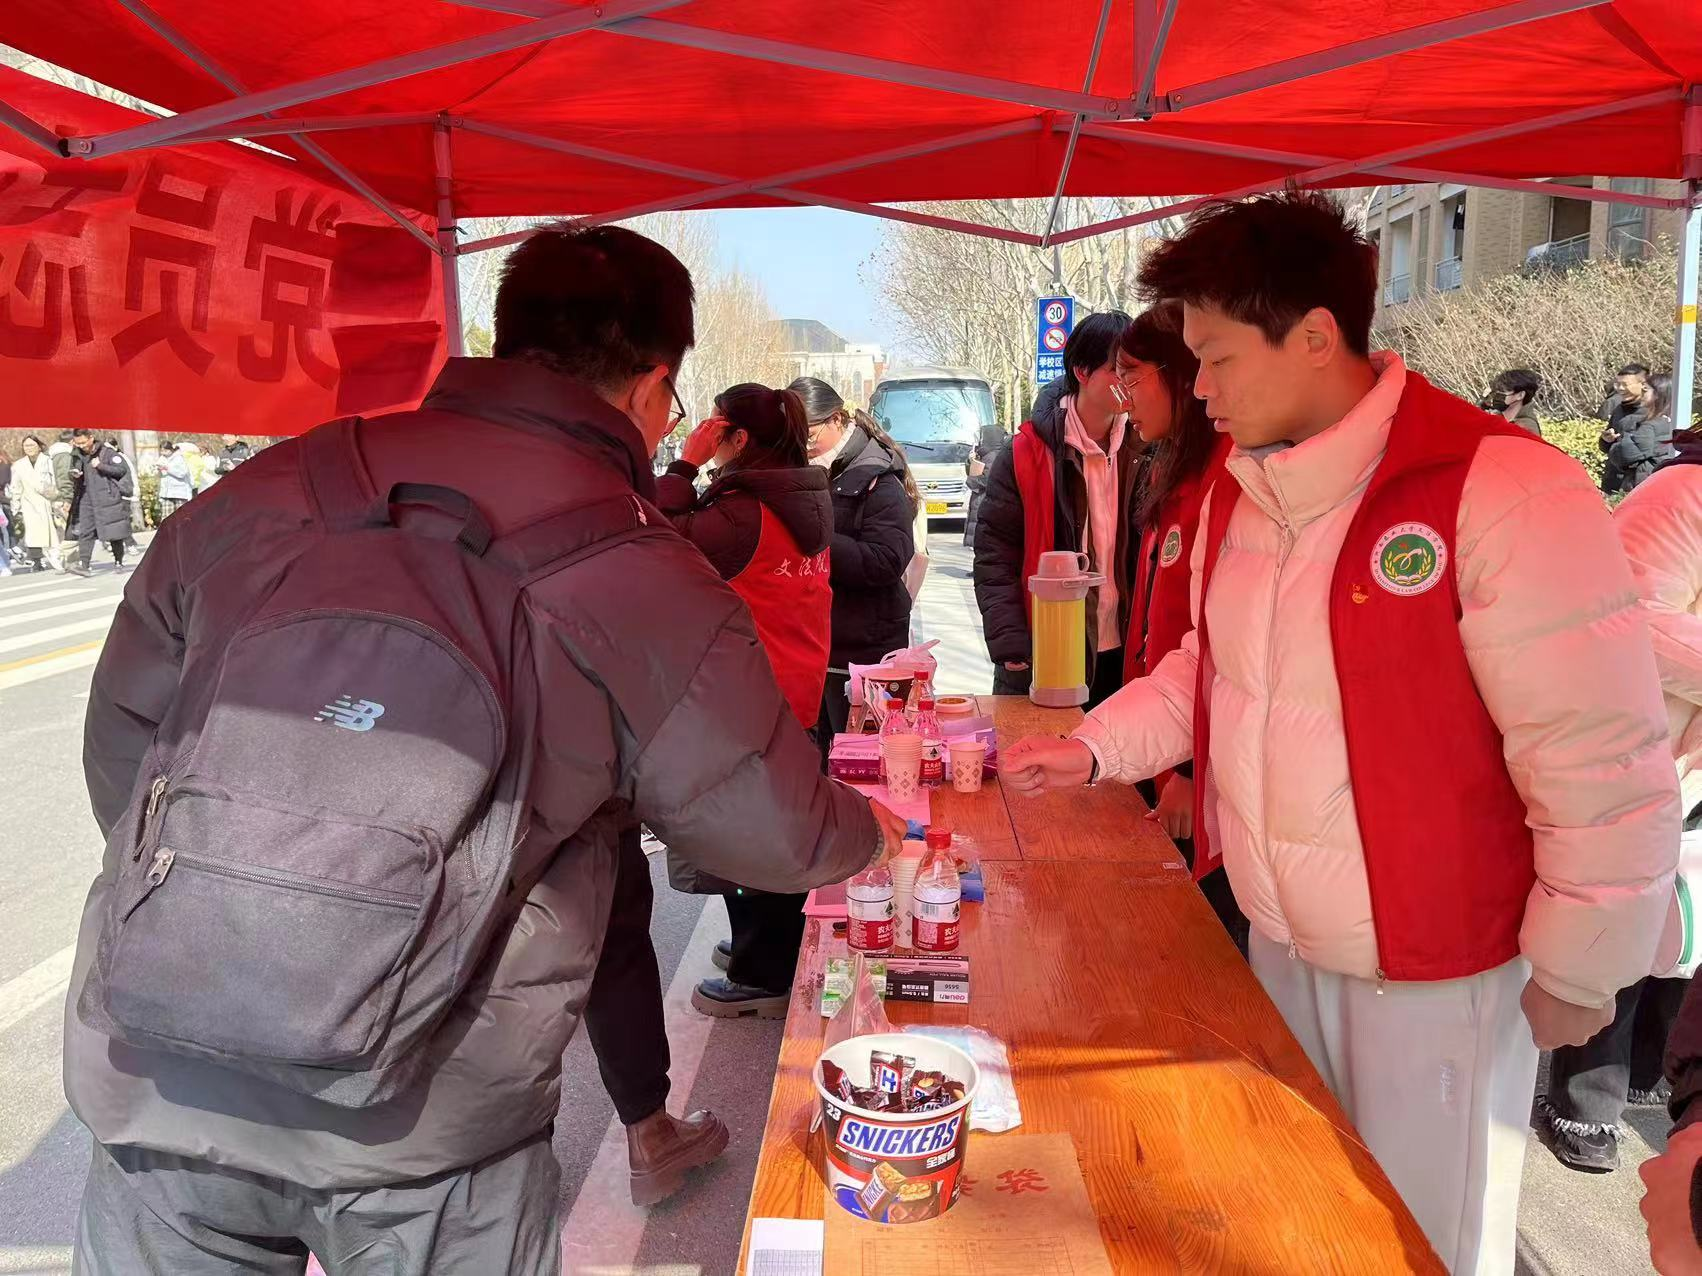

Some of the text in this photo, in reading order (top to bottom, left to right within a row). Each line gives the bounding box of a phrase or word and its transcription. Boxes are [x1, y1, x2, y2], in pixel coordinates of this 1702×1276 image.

[1049, 306, 1062, 320] 30
[877, 923, 893, 935] 农夫
[944, 925, 959, 936] 农夫
[826, 1104, 841, 1121] 23
[843, 1116, 960, 1154] SNICKERS
